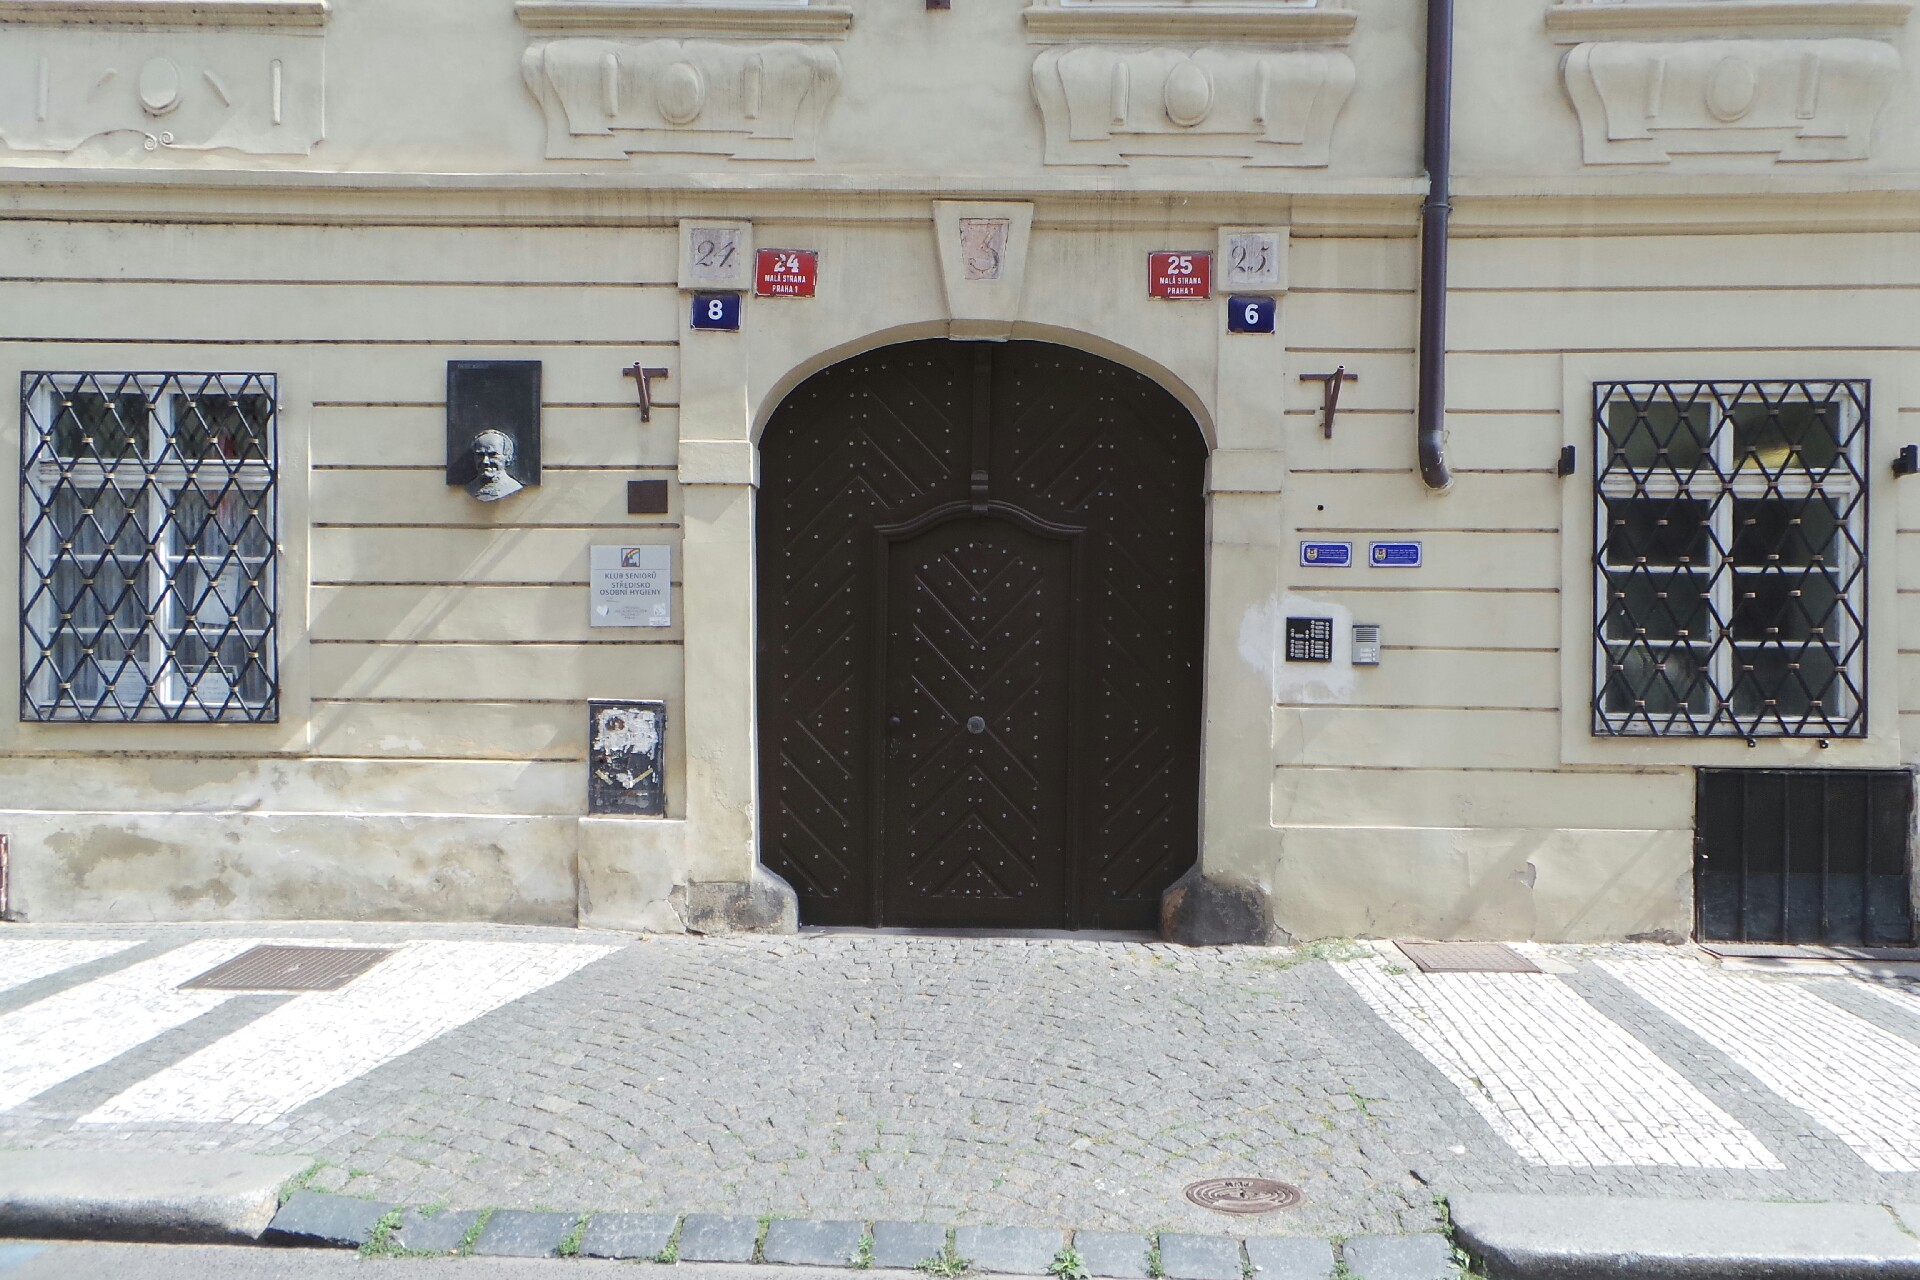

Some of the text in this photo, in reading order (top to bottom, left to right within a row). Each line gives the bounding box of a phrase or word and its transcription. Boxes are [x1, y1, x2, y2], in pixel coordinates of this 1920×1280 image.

[773, 253, 800, 273] 24
[1167, 255, 1193, 275] 25
[764, 272, 806, 283] MALÁ STRANA
[1159, 275, 1202, 285] MALÁ STRANA
[772, 284, 798, 293] PRAHA 1
[1167, 287, 1194, 295] PRAHA 1
[707, 299, 723, 321] 8
[1244, 303, 1259, 325] 6
[604, 571, 657, 580] KLUB SENIORŮ
[611, 581, 651, 589] STŘEDISKO
[599, 588, 628, 596] OSOBNÍ
